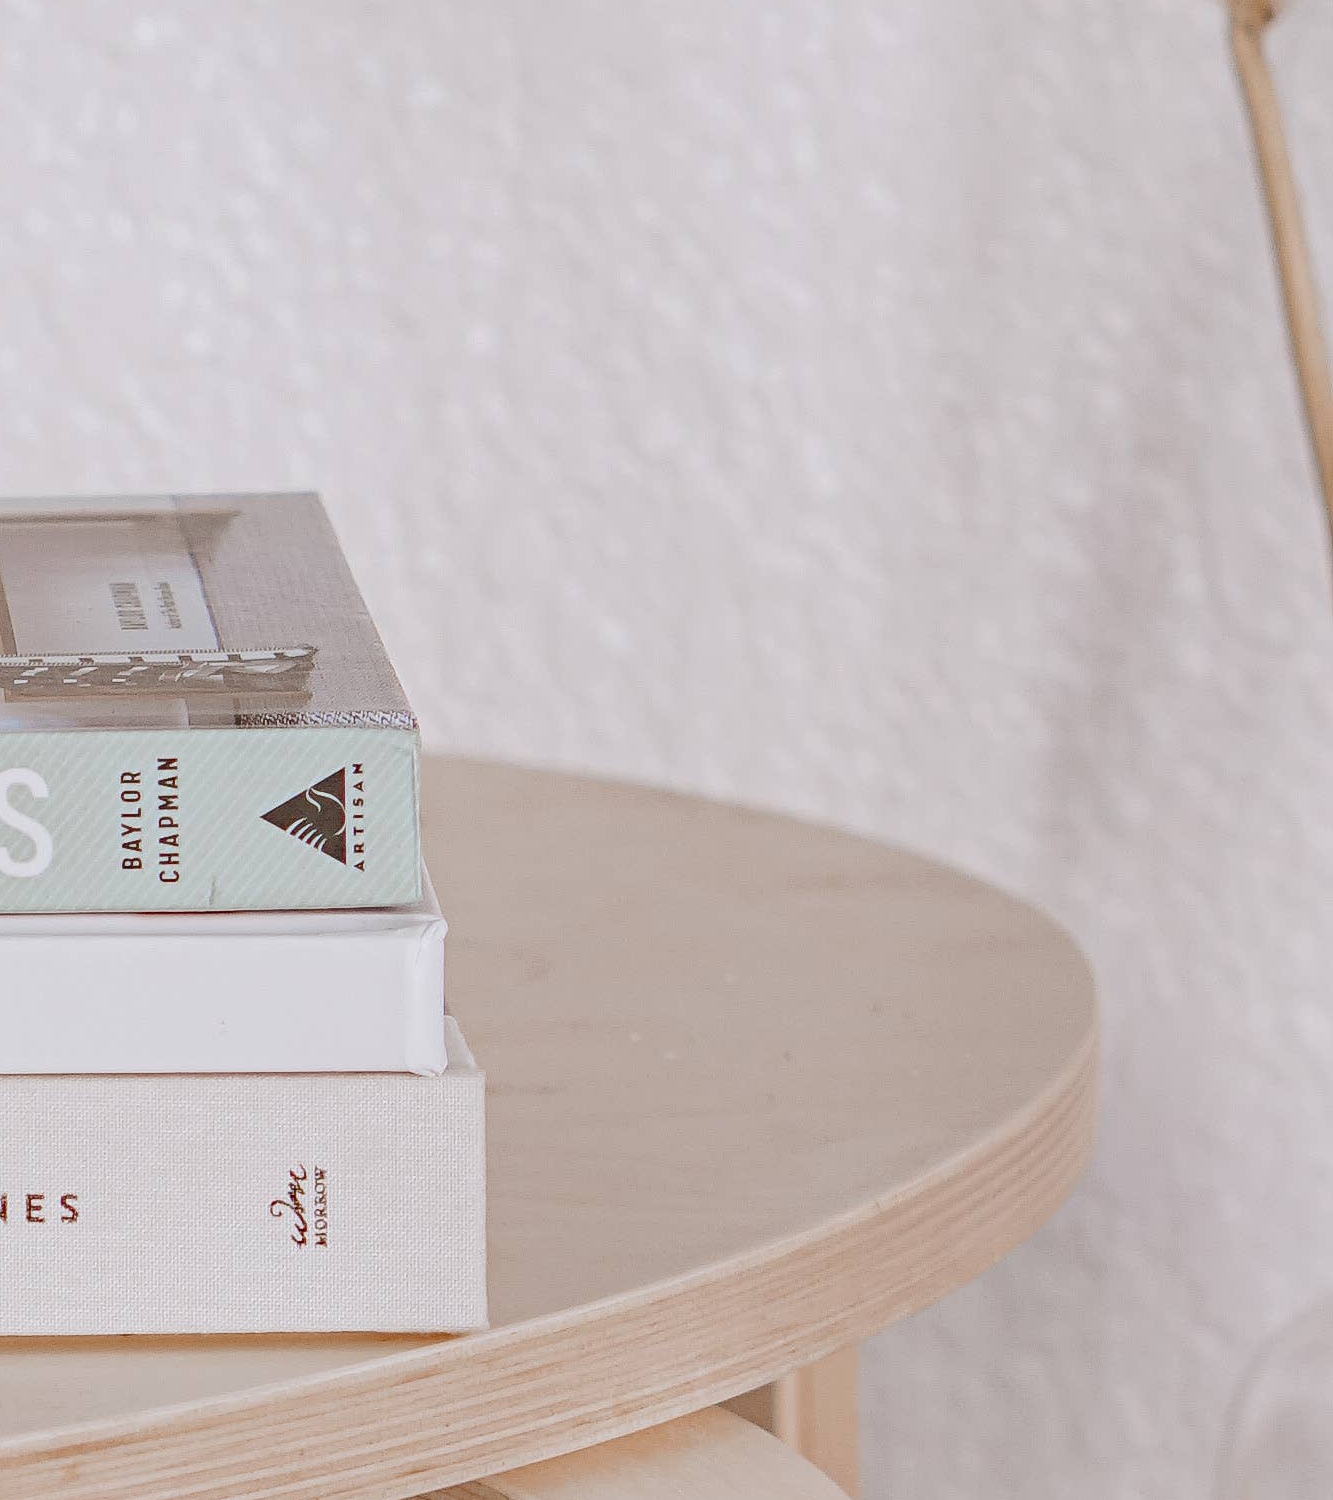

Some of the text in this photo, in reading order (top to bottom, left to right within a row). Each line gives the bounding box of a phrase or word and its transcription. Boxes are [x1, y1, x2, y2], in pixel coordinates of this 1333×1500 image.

[120, 771, 143, 870] BAYLOR
[156, 757, 180, 883] CHAPMAN
[351, 763, 366, 873] ARTISAN
[313, 1165, 328, 1248] MORROW
